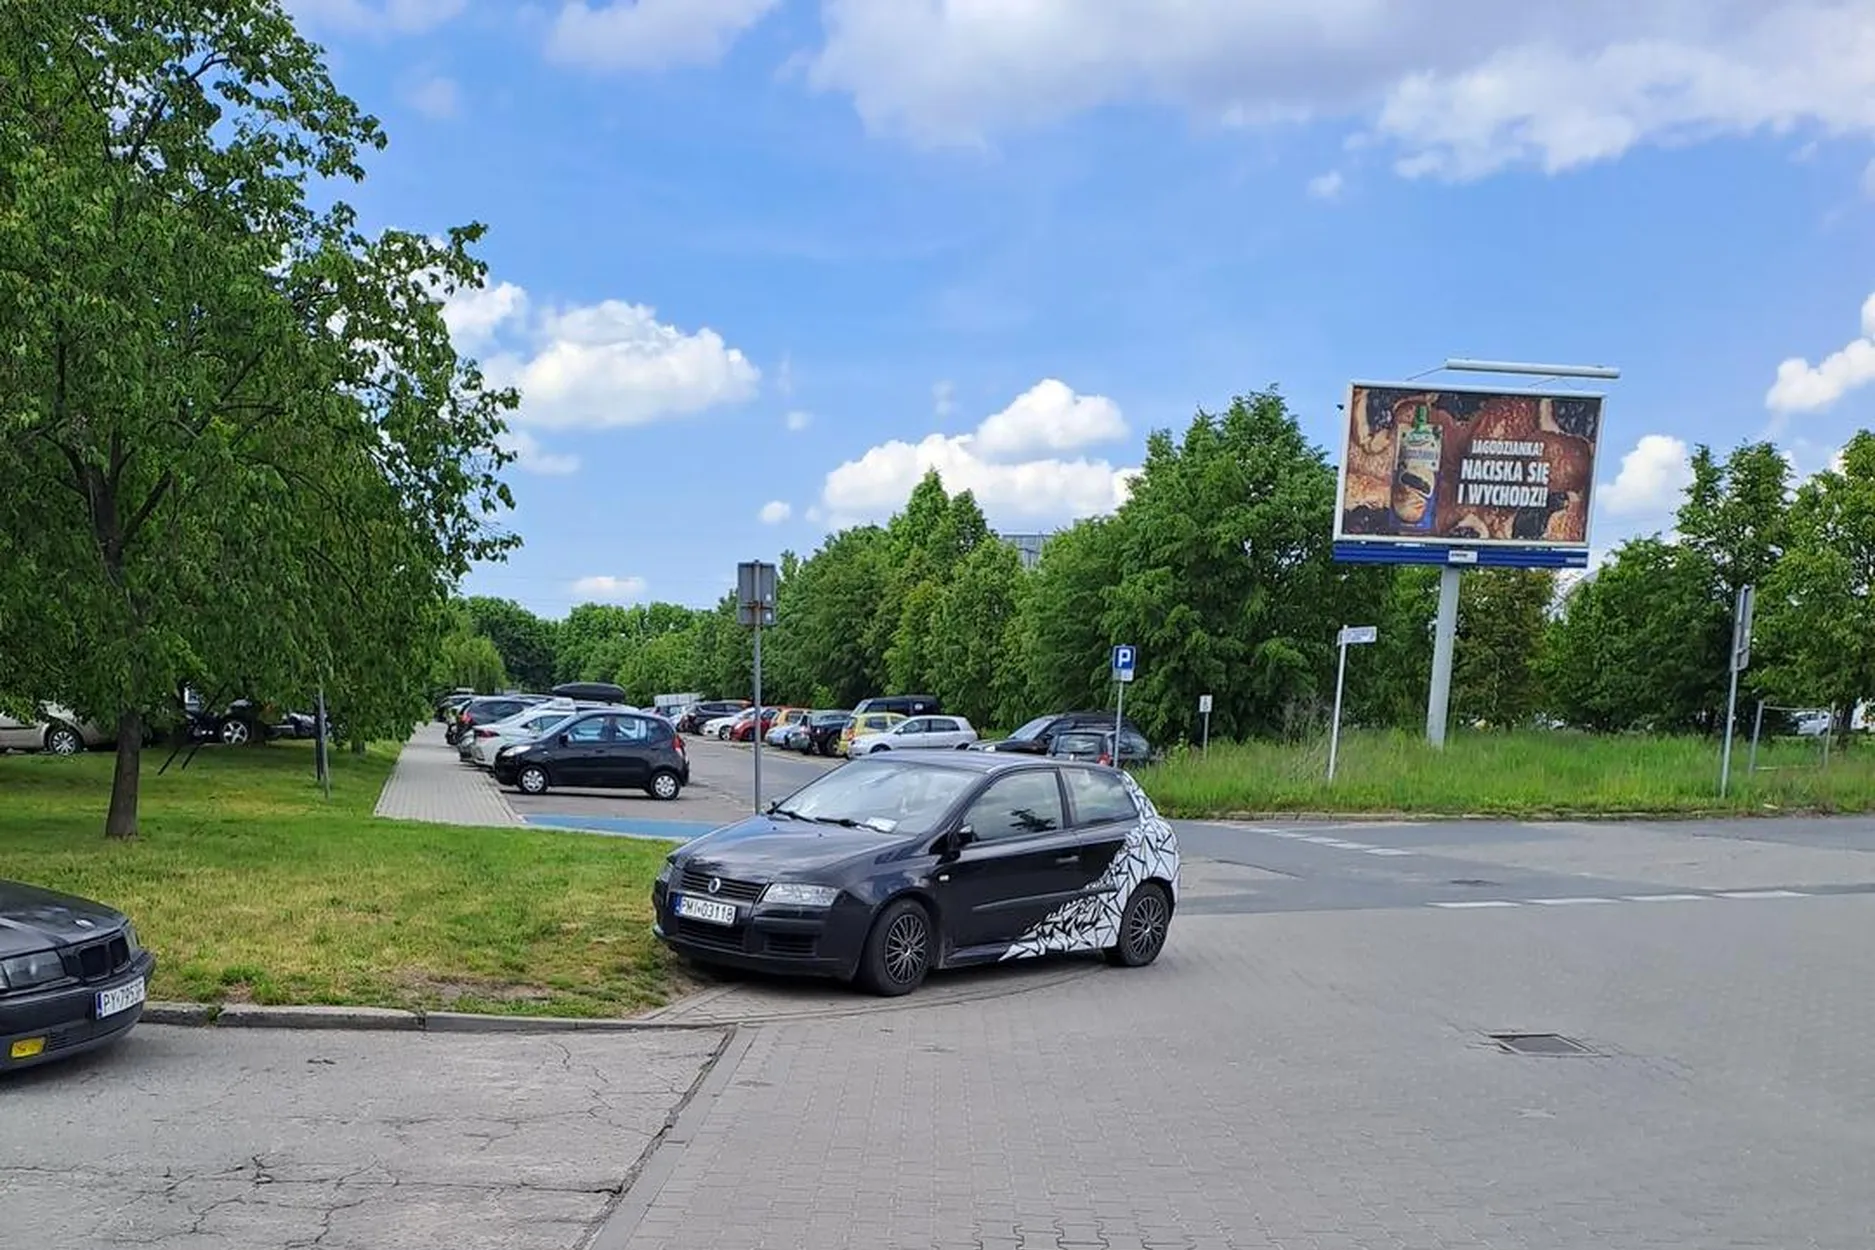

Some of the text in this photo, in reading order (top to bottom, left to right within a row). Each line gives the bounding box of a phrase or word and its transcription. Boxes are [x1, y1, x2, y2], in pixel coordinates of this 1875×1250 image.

[1461, 458, 1550, 485] NACISKA SIĘ
[1457, 483, 1464, 504] I
[1118, 648, 1131, 668] P
